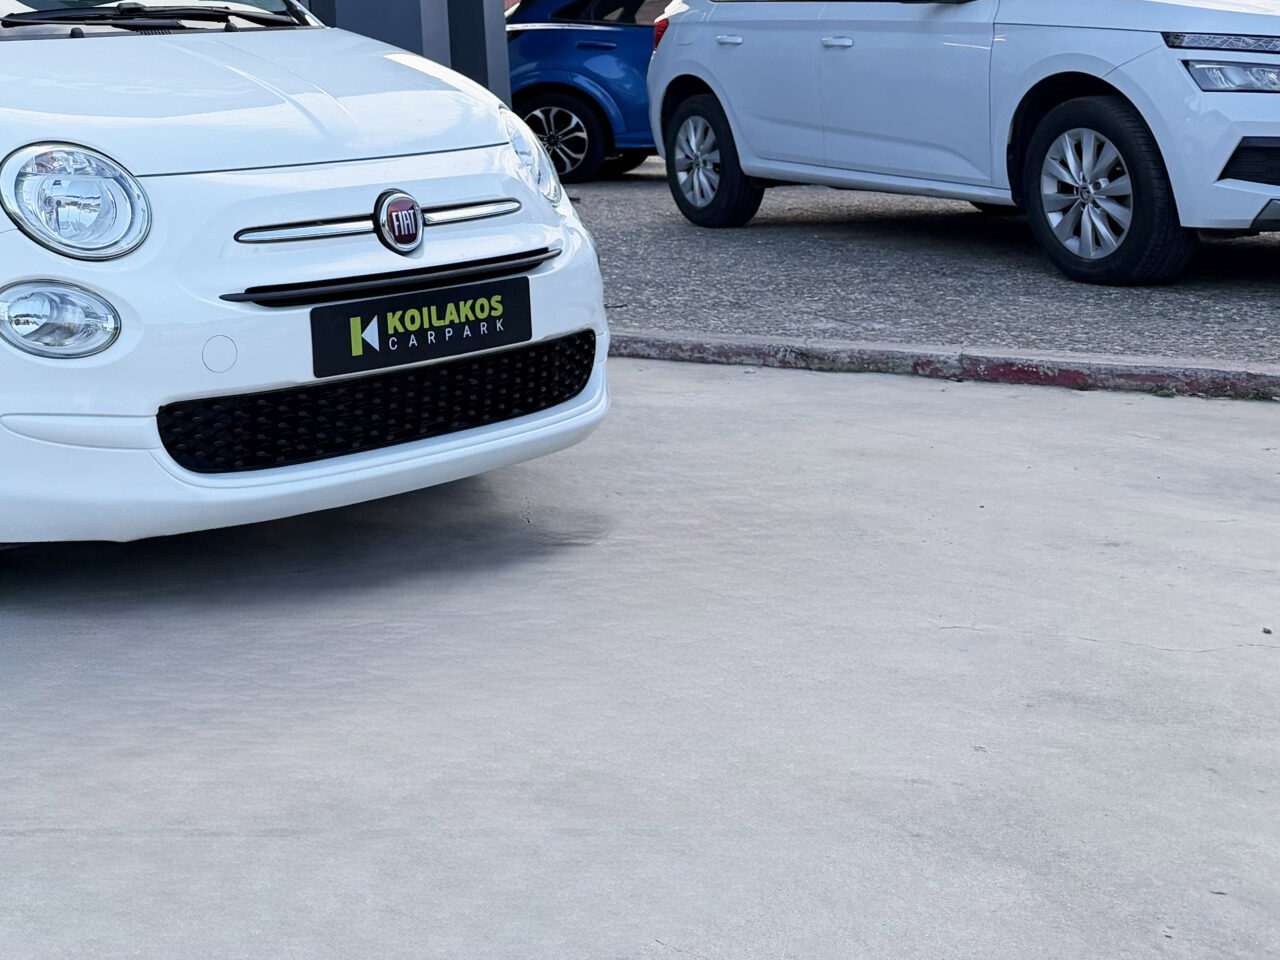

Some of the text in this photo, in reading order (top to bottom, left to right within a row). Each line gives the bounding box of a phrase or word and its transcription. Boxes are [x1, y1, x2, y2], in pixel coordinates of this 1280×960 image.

[391, 210, 416, 237] FIAT
[387, 295, 504, 335] KOILAKOS
[389, 318, 504, 351] CARPARK
